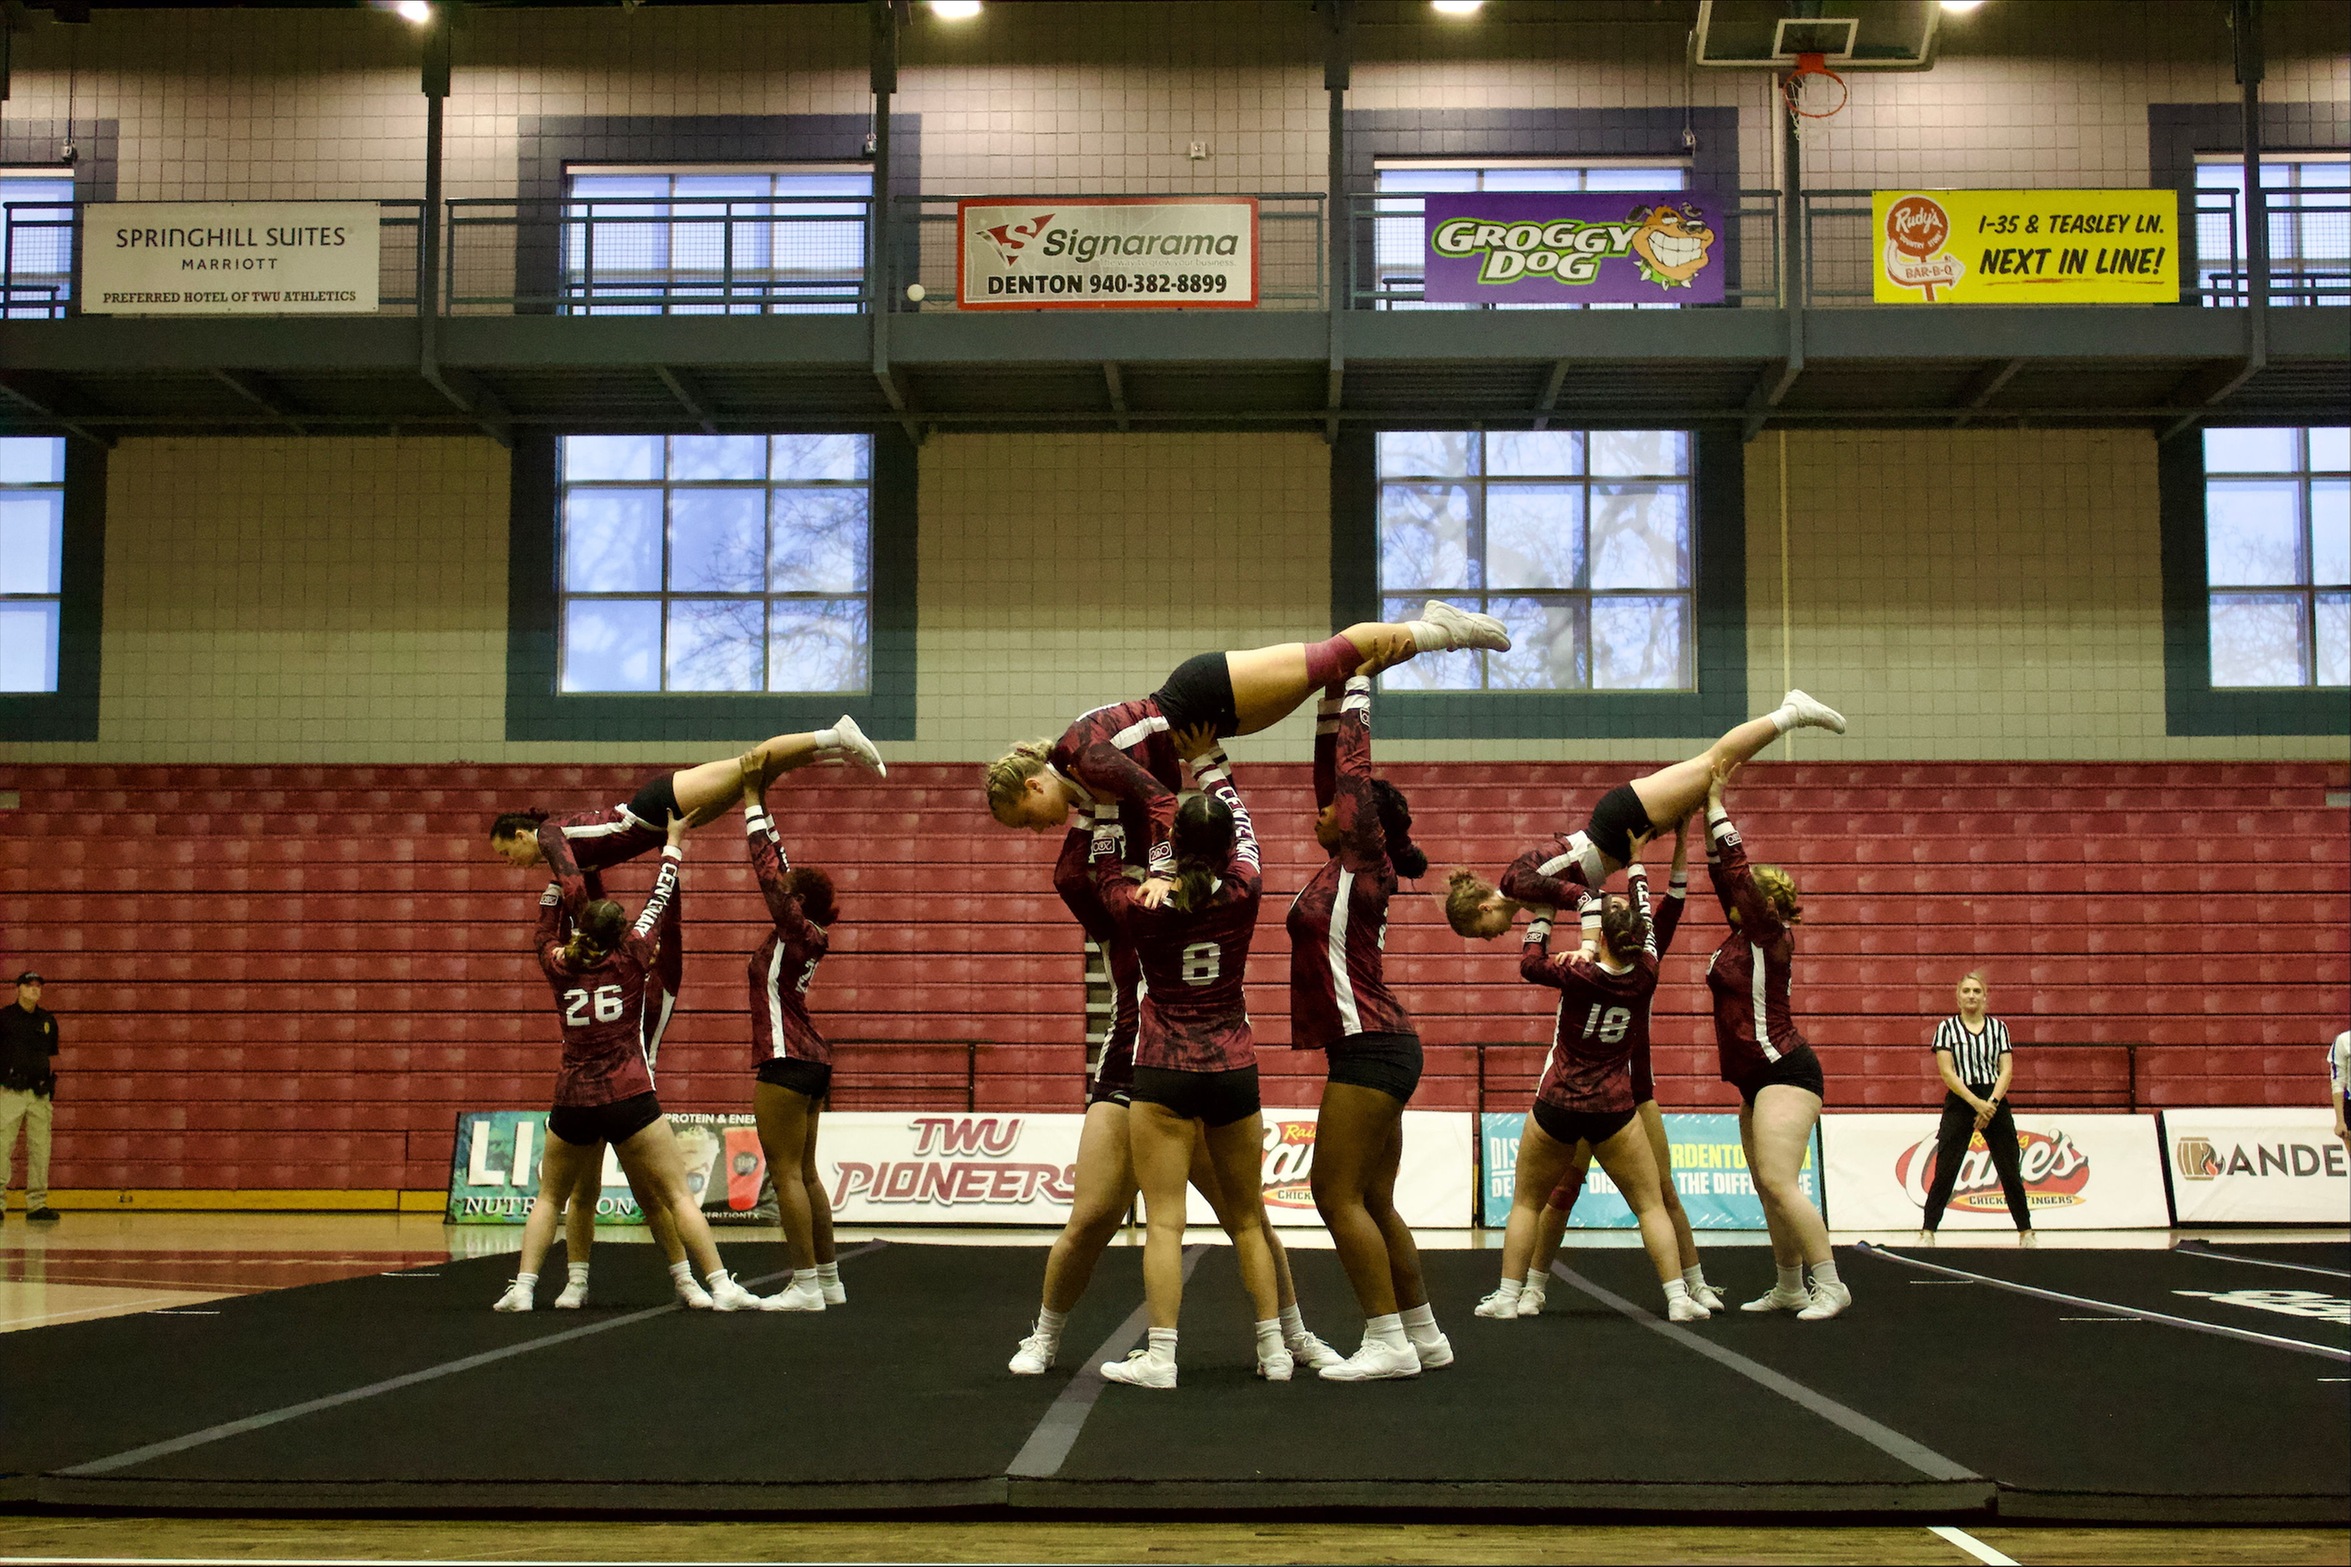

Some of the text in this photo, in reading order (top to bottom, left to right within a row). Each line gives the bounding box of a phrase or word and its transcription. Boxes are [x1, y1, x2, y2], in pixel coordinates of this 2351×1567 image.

[1895, 206, 1944, 234] Rudy's
[1978, 213, 2165, 234] I-35 & TEASLEY LN.
[116, 227, 346, 248] SPRINGHILL SUITES
[1042, 228, 1240, 263] Signarama
[1436, 221, 1640, 254] GROGGY
[181, 258, 279, 271] MARRIOTT
[1485, 250, 1597, 280] DOG
[1905, 264, 1953, 279] BAR-B-Q
[1978, 246, 2166, 275] NEXT IN LINE!
[103, 291, 356, 303] PREFERRED HOTEL OF TWU ATHLETICS
[988, 273, 1228, 295] DENTON 940-382-8899
[1182, 941, 1222, 986] 8
[563, 984, 624, 1027] 26
[1582, 1003, 1632, 1044] 18
[717, 1113, 727, 1123] &
[911, 1117, 1022, 1154] TWU
[1678, 1172, 1710, 1195] THE
